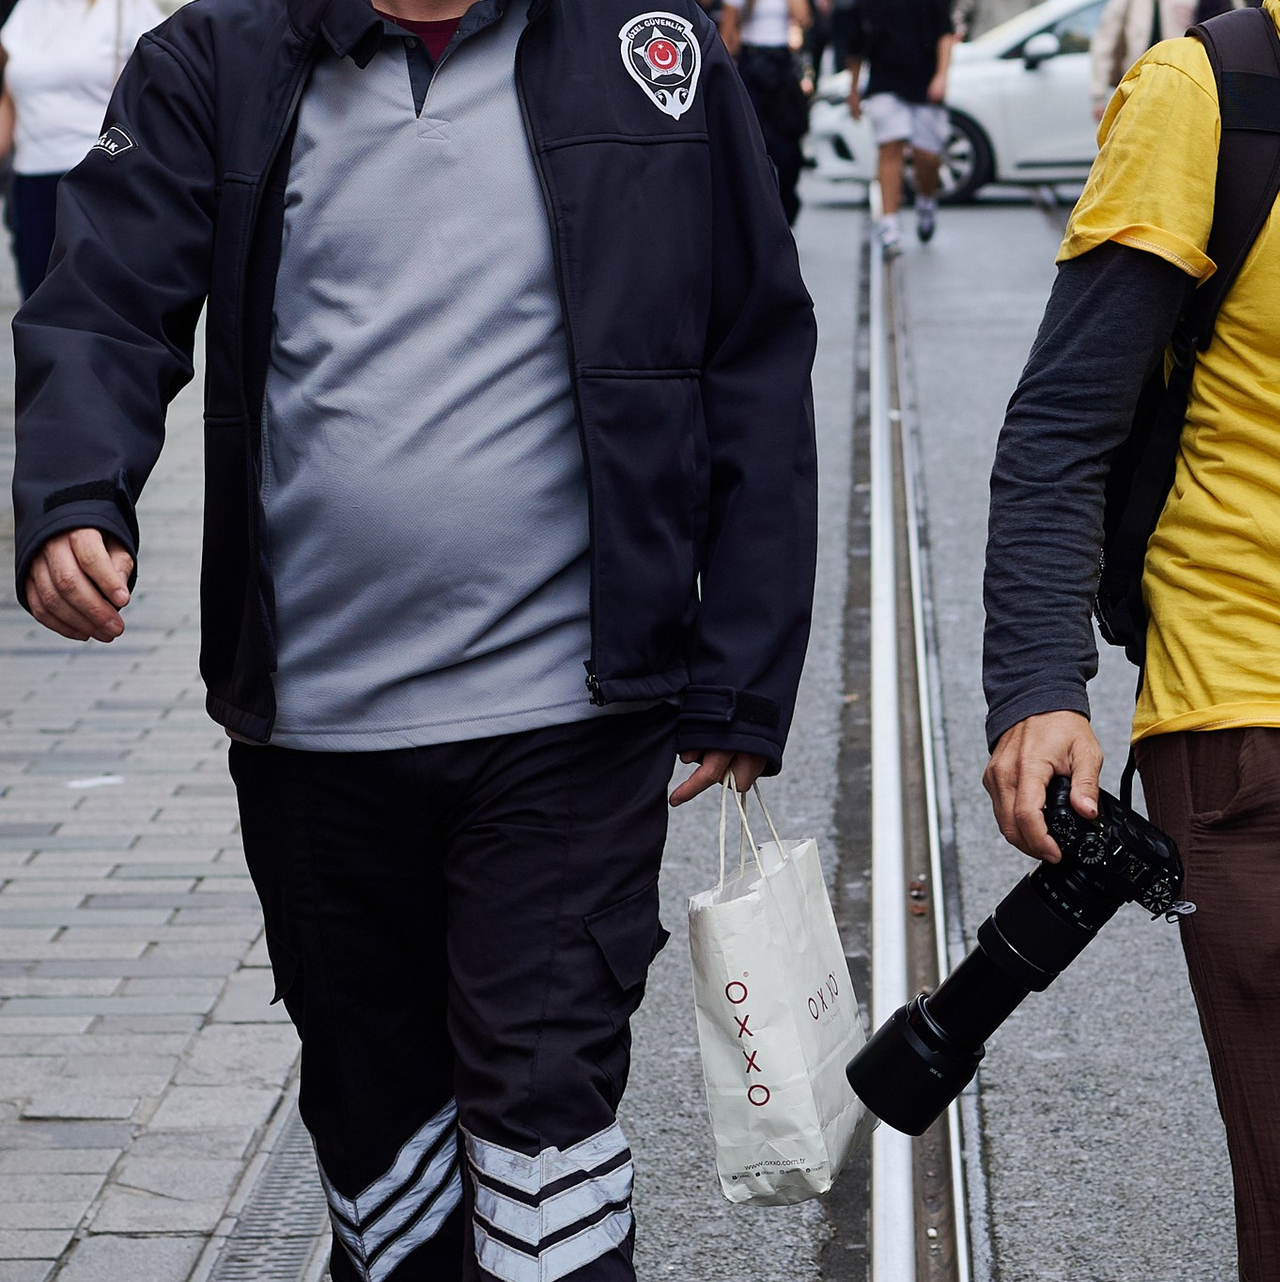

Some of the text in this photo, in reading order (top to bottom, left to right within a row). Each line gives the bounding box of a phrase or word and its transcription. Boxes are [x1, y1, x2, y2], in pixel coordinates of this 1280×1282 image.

[627, 18, 685, 39] ÖZEL GÜVENLİK
[725, 981, 770, 1107] OXXO
[744, 1158, 806, 1171] www.oxxo.com.tr
